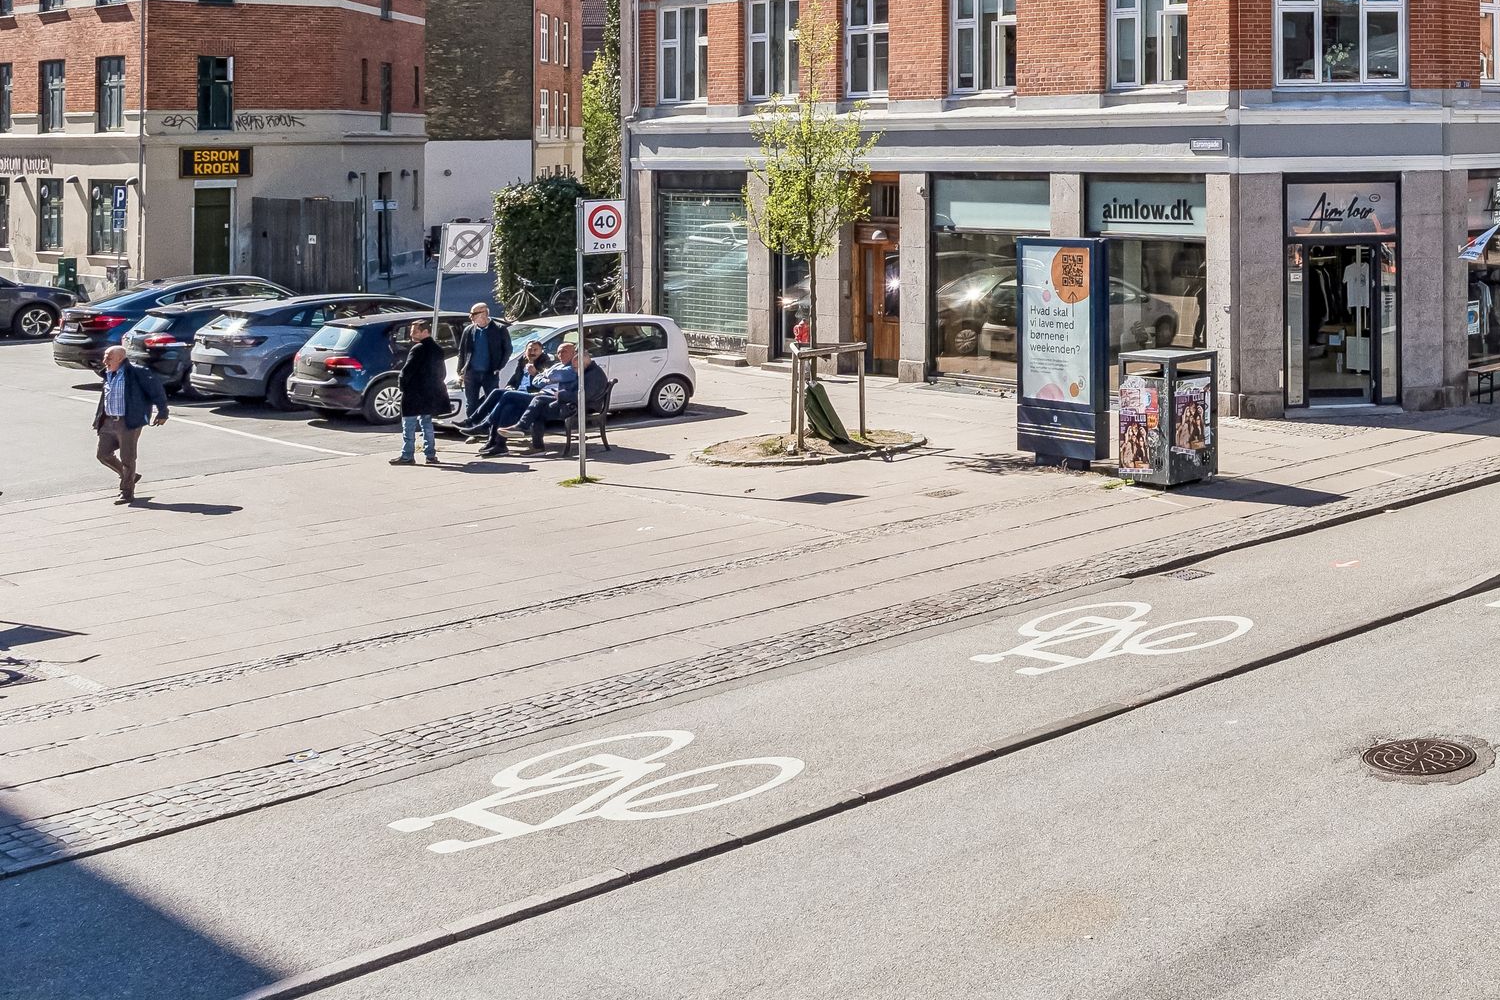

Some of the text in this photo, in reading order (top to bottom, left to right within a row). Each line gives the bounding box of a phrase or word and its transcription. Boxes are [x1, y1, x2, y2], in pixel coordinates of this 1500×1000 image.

[1193, 140, 1219, 149] Esromgade
[194, 150, 239, 162] ESROM
[194, 163, 239, 174] KROEN
[116, 189, 125, 207] P
[1102, 197, 1194, 221] aimlow.dk
[1301, 192, 1346, 231] Aim
[594, 215, 616, 229] 40
[593, 242, 617, 250] Zone
[1030, 305, 1069, 317] Hvad skal
[1030, 319, 1075, 330] vi lave med
[1030, 331, 1065, 342] børnene
[1030, 343, 1081, 355] weekenden?
